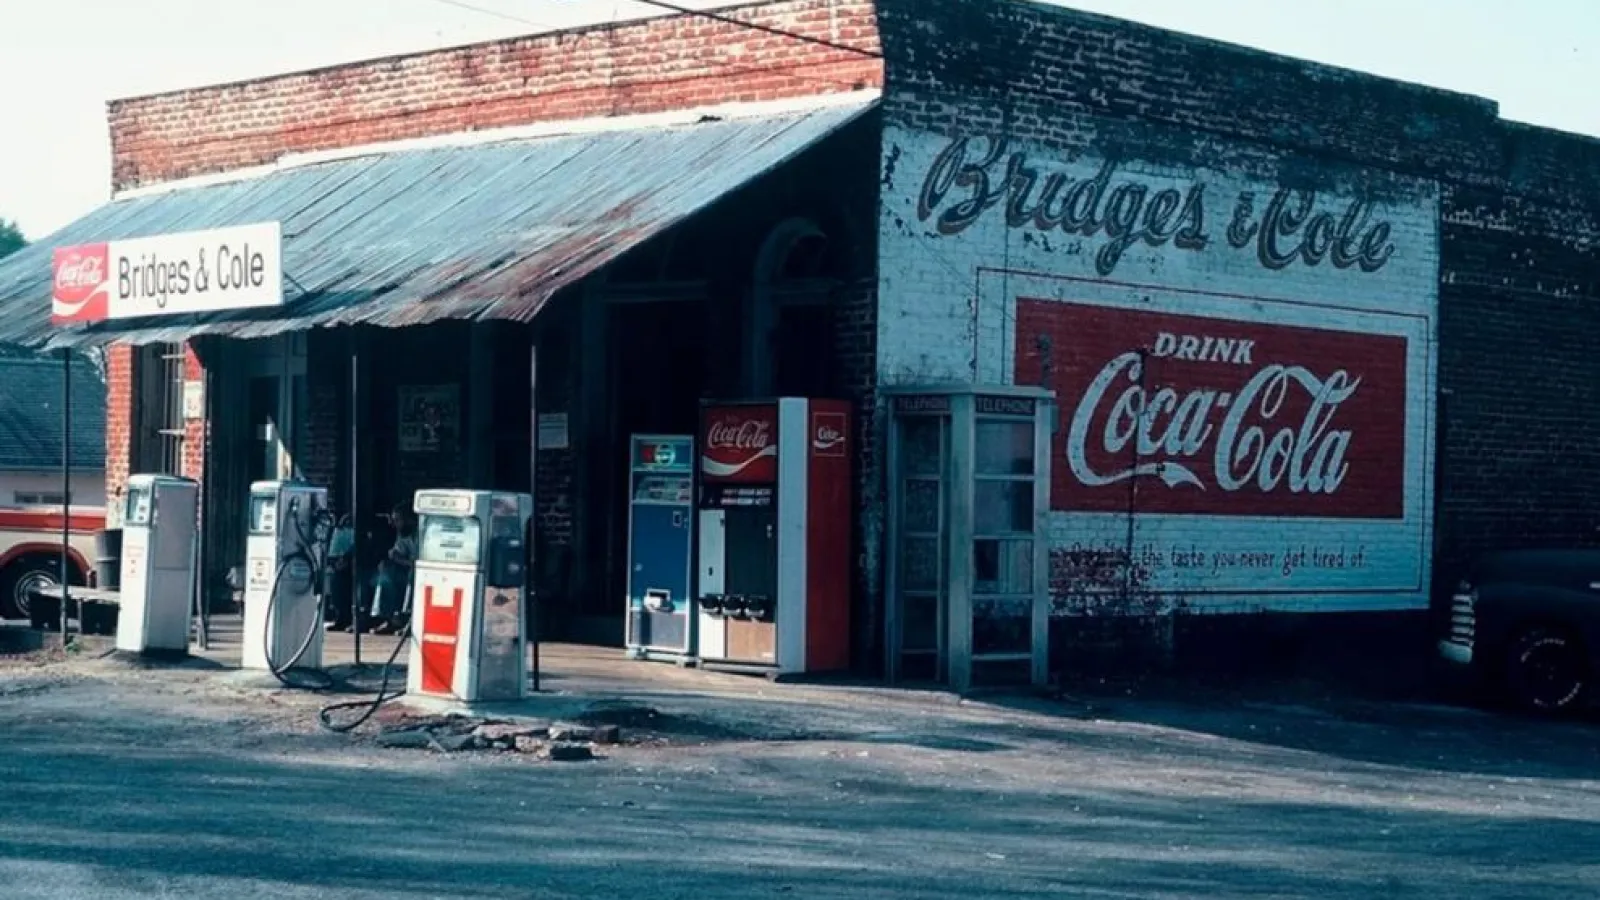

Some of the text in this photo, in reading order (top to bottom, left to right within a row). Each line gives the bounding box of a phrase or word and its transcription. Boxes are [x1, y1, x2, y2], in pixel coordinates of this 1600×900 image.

[920, 133, 1206, 275] Bridges
[1257, 186, 1395, 272] Cole
[119, 253, 190, 307] Bridges
[194, 247, 209, 292] &
[216, 242, 265, 289] Cole
[1153, 331, 1256, 365] DRINK
[1067, 350, 1361, 495] Coca-Cola
[1142, 544, 1164, 567] the
[1171, 544, 1206, 567] taste
[1212, 550, 1237, 575] you
[1240, 552, 1276, 567] never
[1283, 544, 1305, 577] get
[1312, 546, 1344, 568] tired
